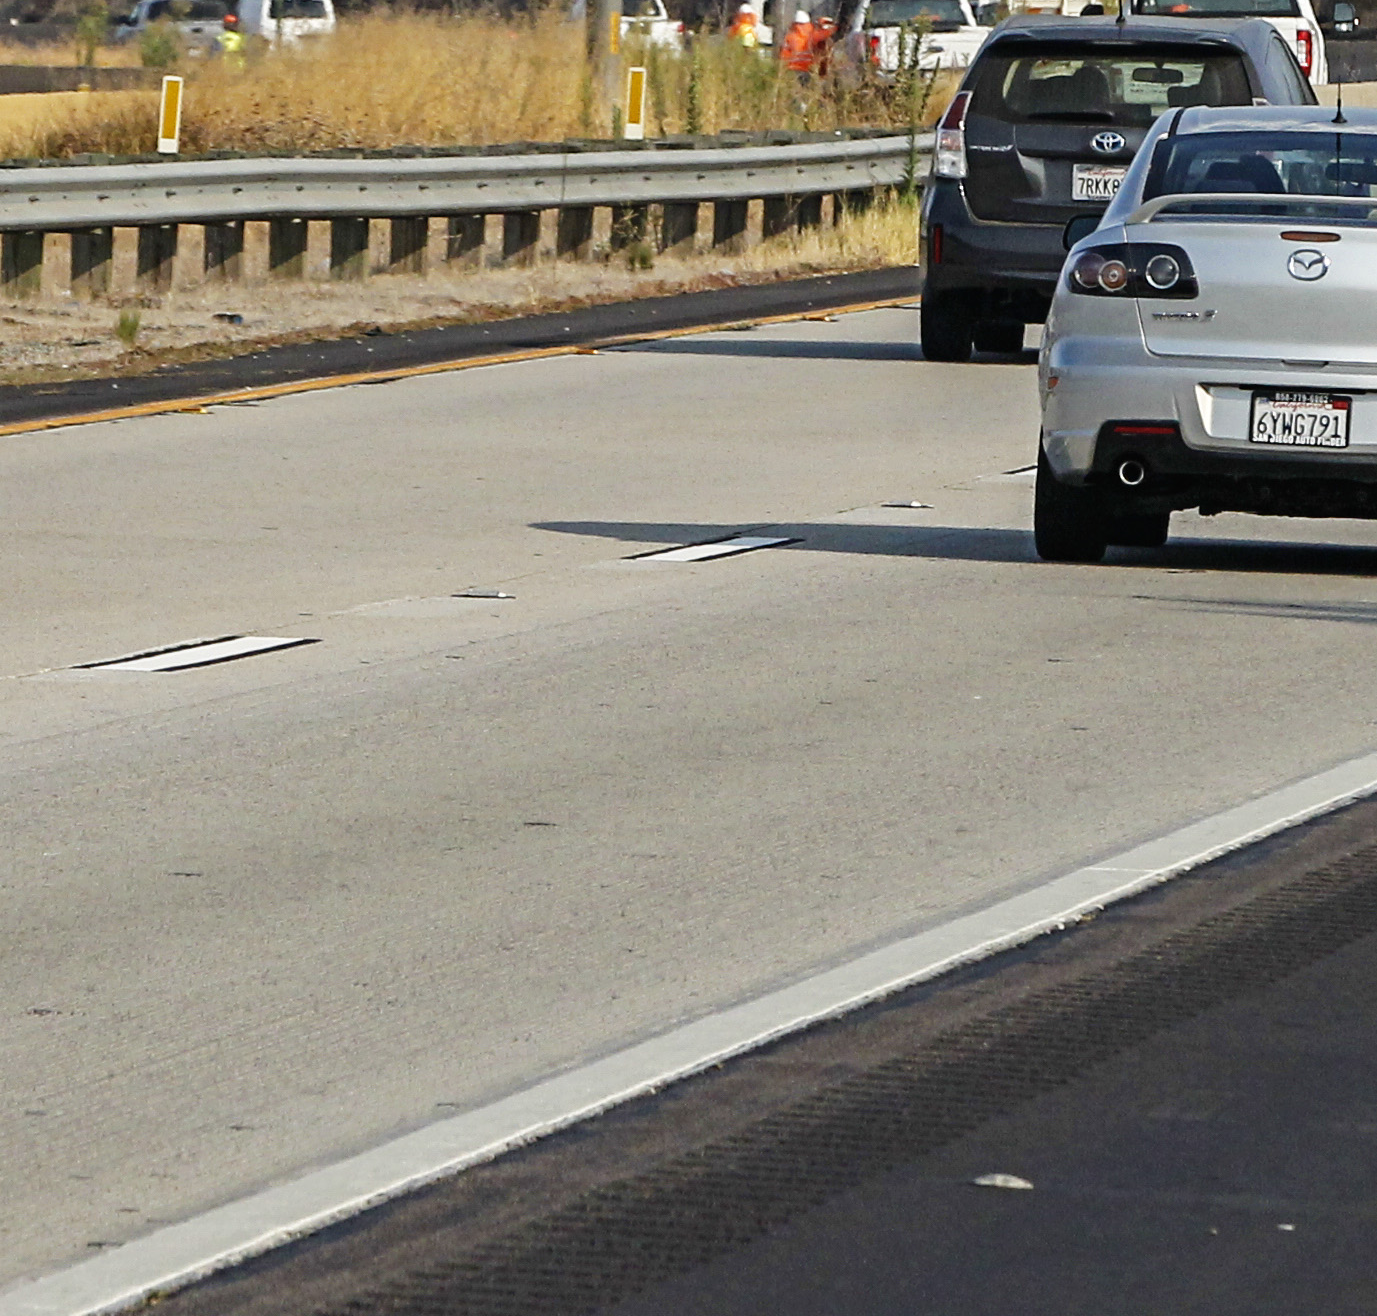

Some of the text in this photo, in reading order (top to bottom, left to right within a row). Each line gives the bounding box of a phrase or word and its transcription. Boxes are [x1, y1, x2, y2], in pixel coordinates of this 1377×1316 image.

[1077, 177, 1125, 195] 7RKK8
[1257, 411, 1342, 439] 6YWG791
[1252, 434, 1269, 442] SAN
[1269, 435, 1294, 444] DIEGO
[1295, 436, 1316, 445] AUTO
